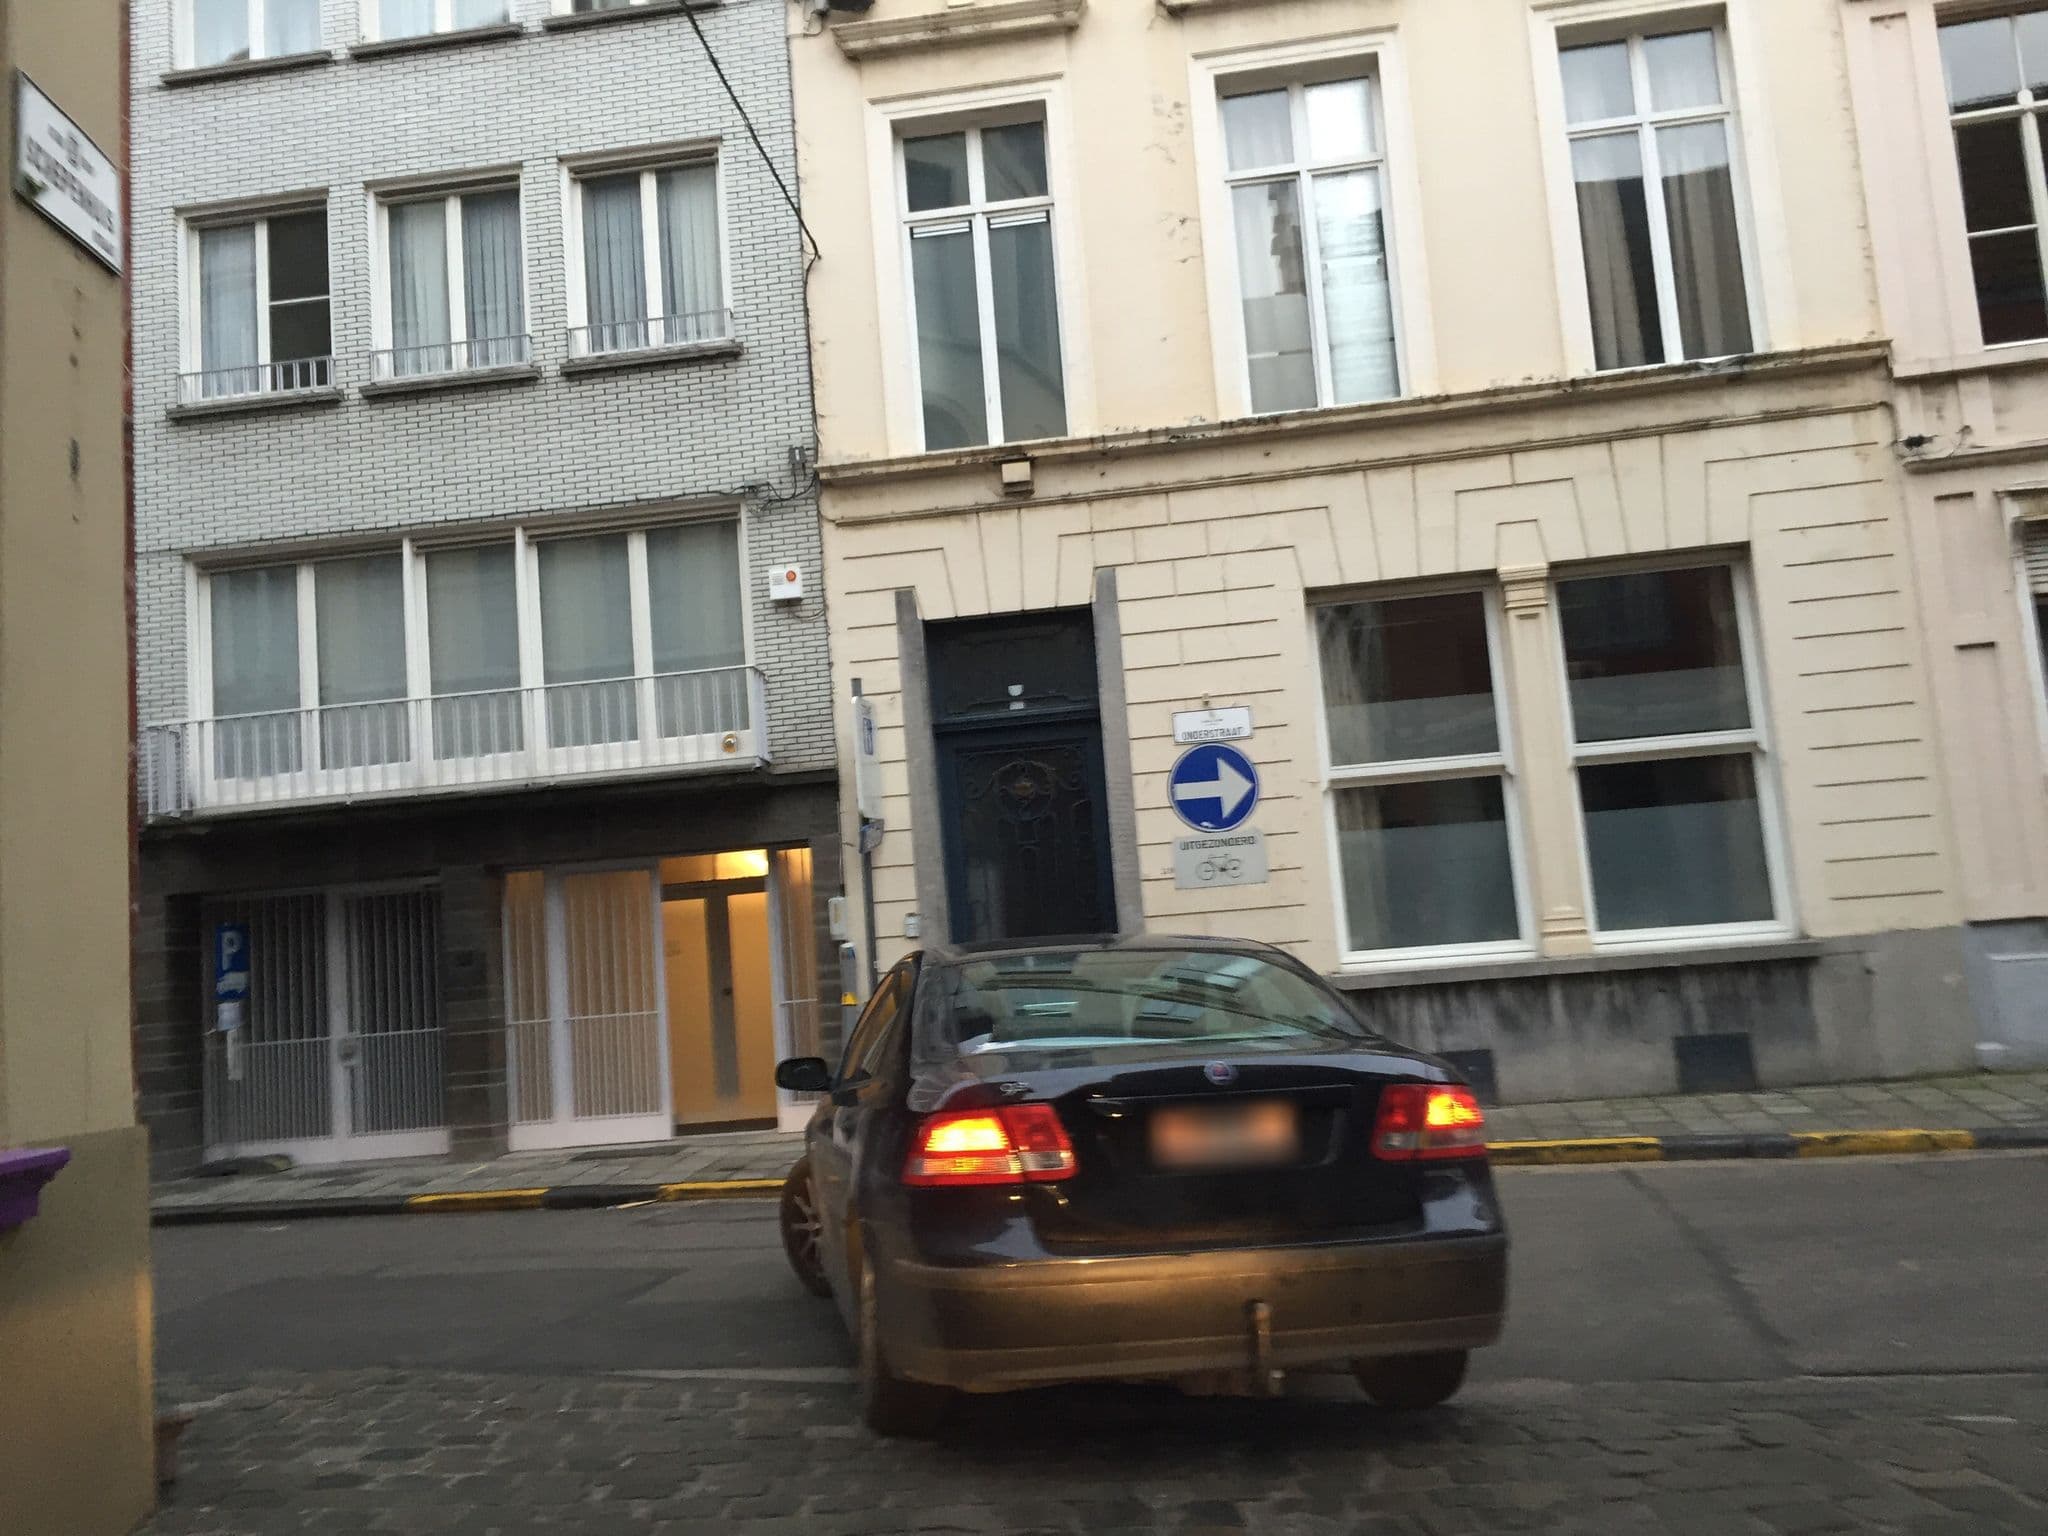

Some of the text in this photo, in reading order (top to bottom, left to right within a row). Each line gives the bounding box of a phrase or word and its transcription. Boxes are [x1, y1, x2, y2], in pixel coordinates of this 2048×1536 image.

[1181, 726, 1243, 740] ONDERSTRAAT
[1179, 836, 1255, 850] UITGEZONDERD
[221, 931, 242, 971] P
